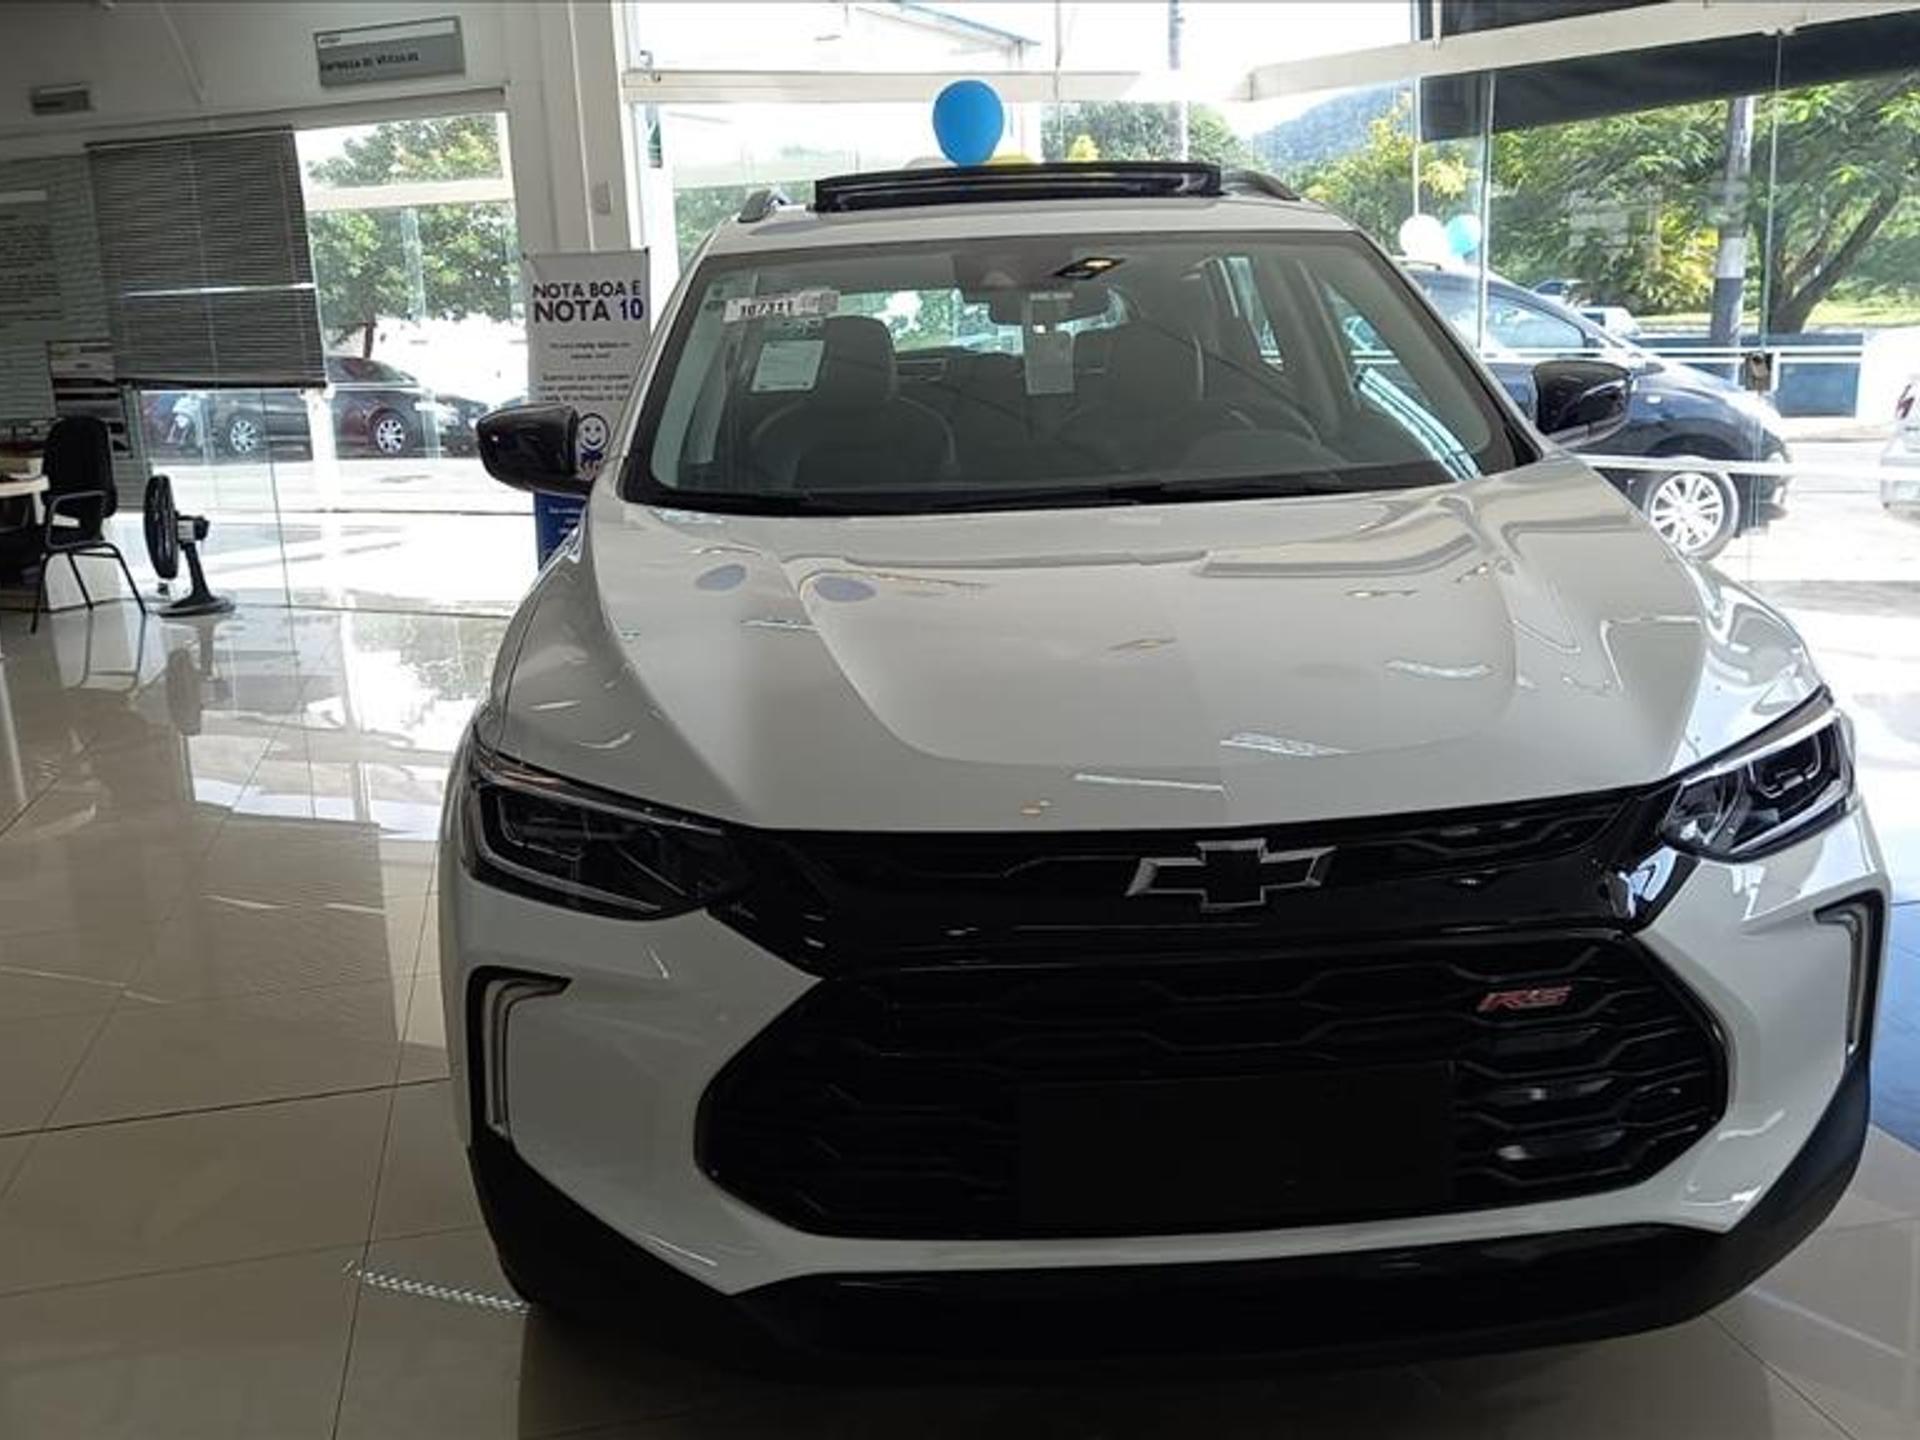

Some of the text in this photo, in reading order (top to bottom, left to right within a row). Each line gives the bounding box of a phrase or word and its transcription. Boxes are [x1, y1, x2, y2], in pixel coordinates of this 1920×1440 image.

[533, 280, 641, 299] NOTA BOA E
[534, 298, 644, 323] NOTA 10
[1476, 986, 1572, 1012] RS
